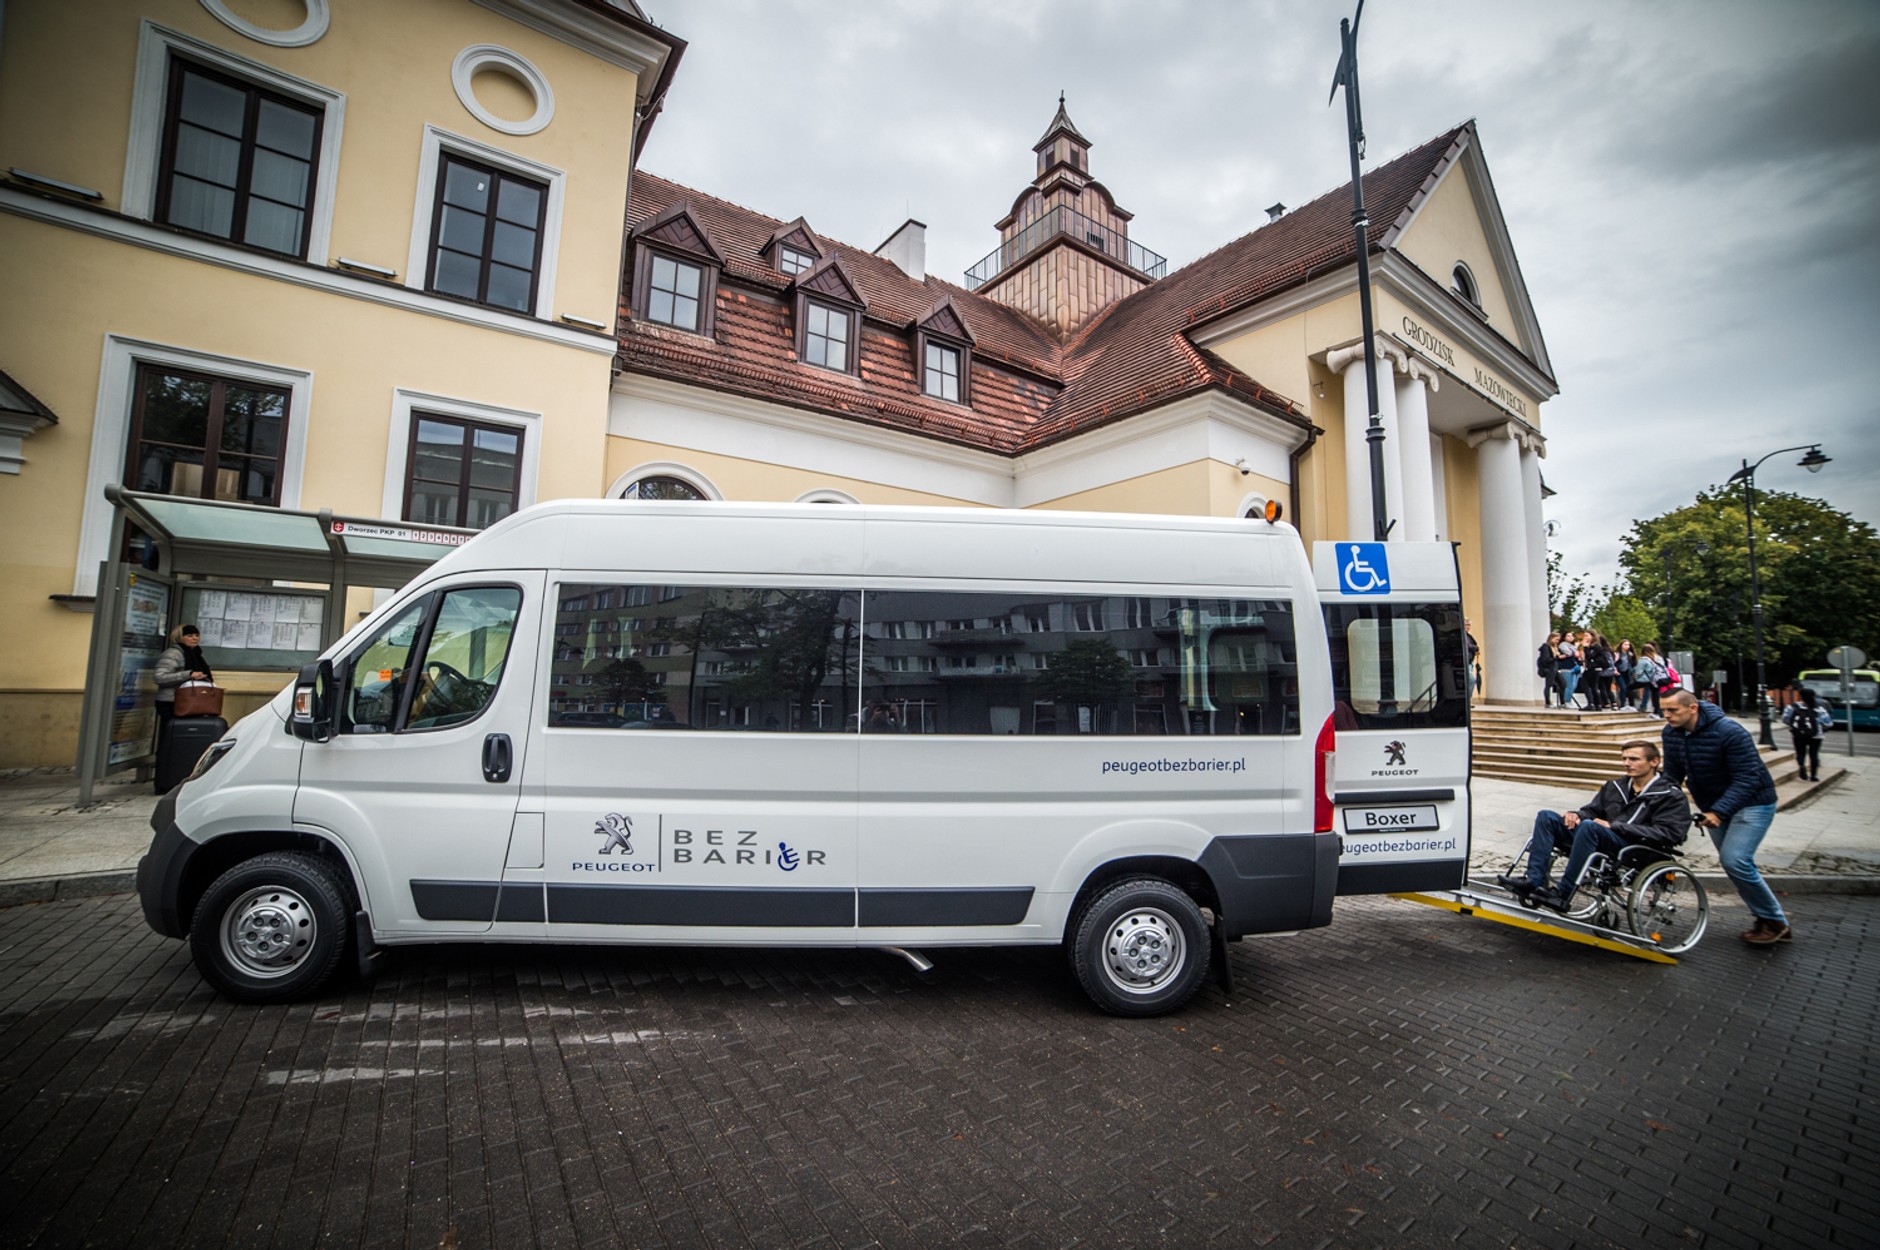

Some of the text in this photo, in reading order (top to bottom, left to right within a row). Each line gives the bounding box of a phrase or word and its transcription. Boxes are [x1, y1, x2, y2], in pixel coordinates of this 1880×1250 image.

[1402, 316, 1527, 417] GRODZISK MAZOWIECKI
[348, 525, 379, 535] Dworzec
[380, 528, 395, 536] PKP
[1102, 757, 1246, 775] peugeotbezbarier.pl
[1365, 812, 1417, 826] Boxer
[674, 829, 758, 846] BEZ
[1342, 837, 1456, 856] ugeotbezbarier.pl
[674, 845, 826, 870] BARIER
[572, 862, 656, 872] PEUGEOT
